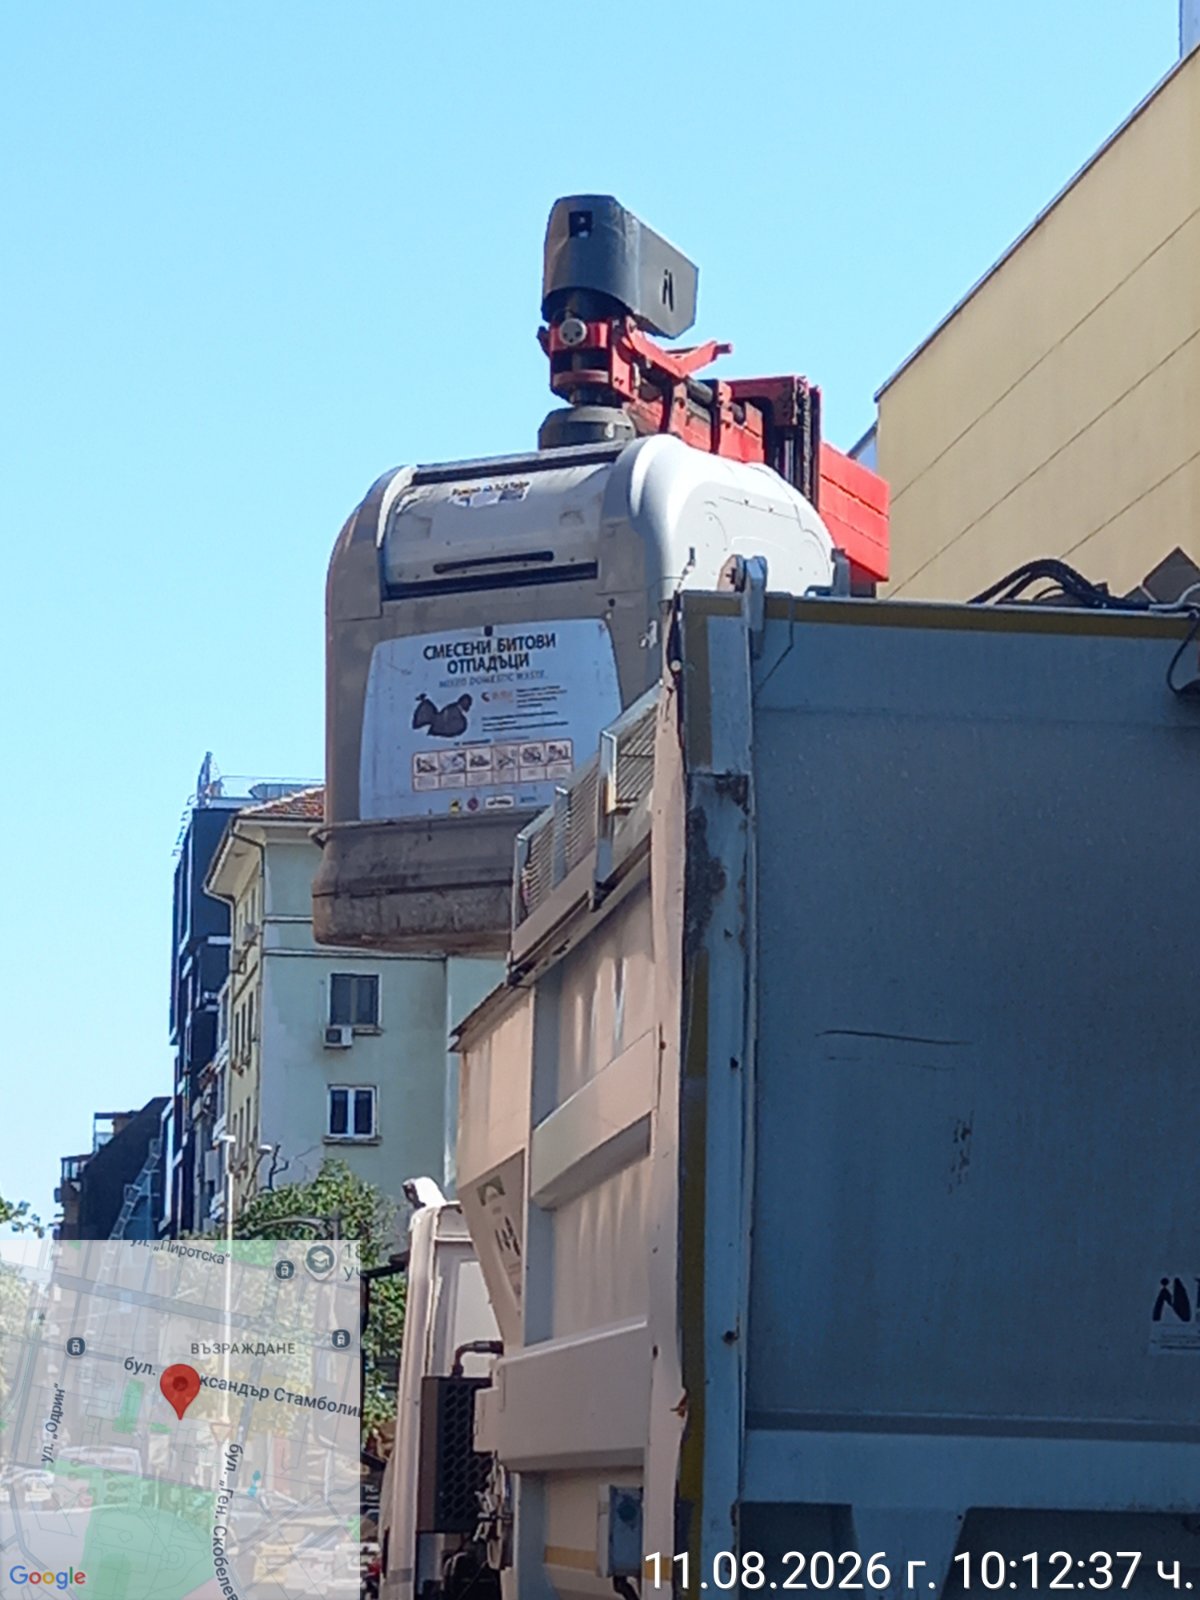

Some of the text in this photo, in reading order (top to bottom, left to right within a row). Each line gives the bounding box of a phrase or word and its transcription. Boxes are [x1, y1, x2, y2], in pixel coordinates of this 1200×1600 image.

[423, 633, 556, 660] СМЕСЕНИ БИТОВИ
[447, 652, 530, 675] ОТПАДЪЦИ
